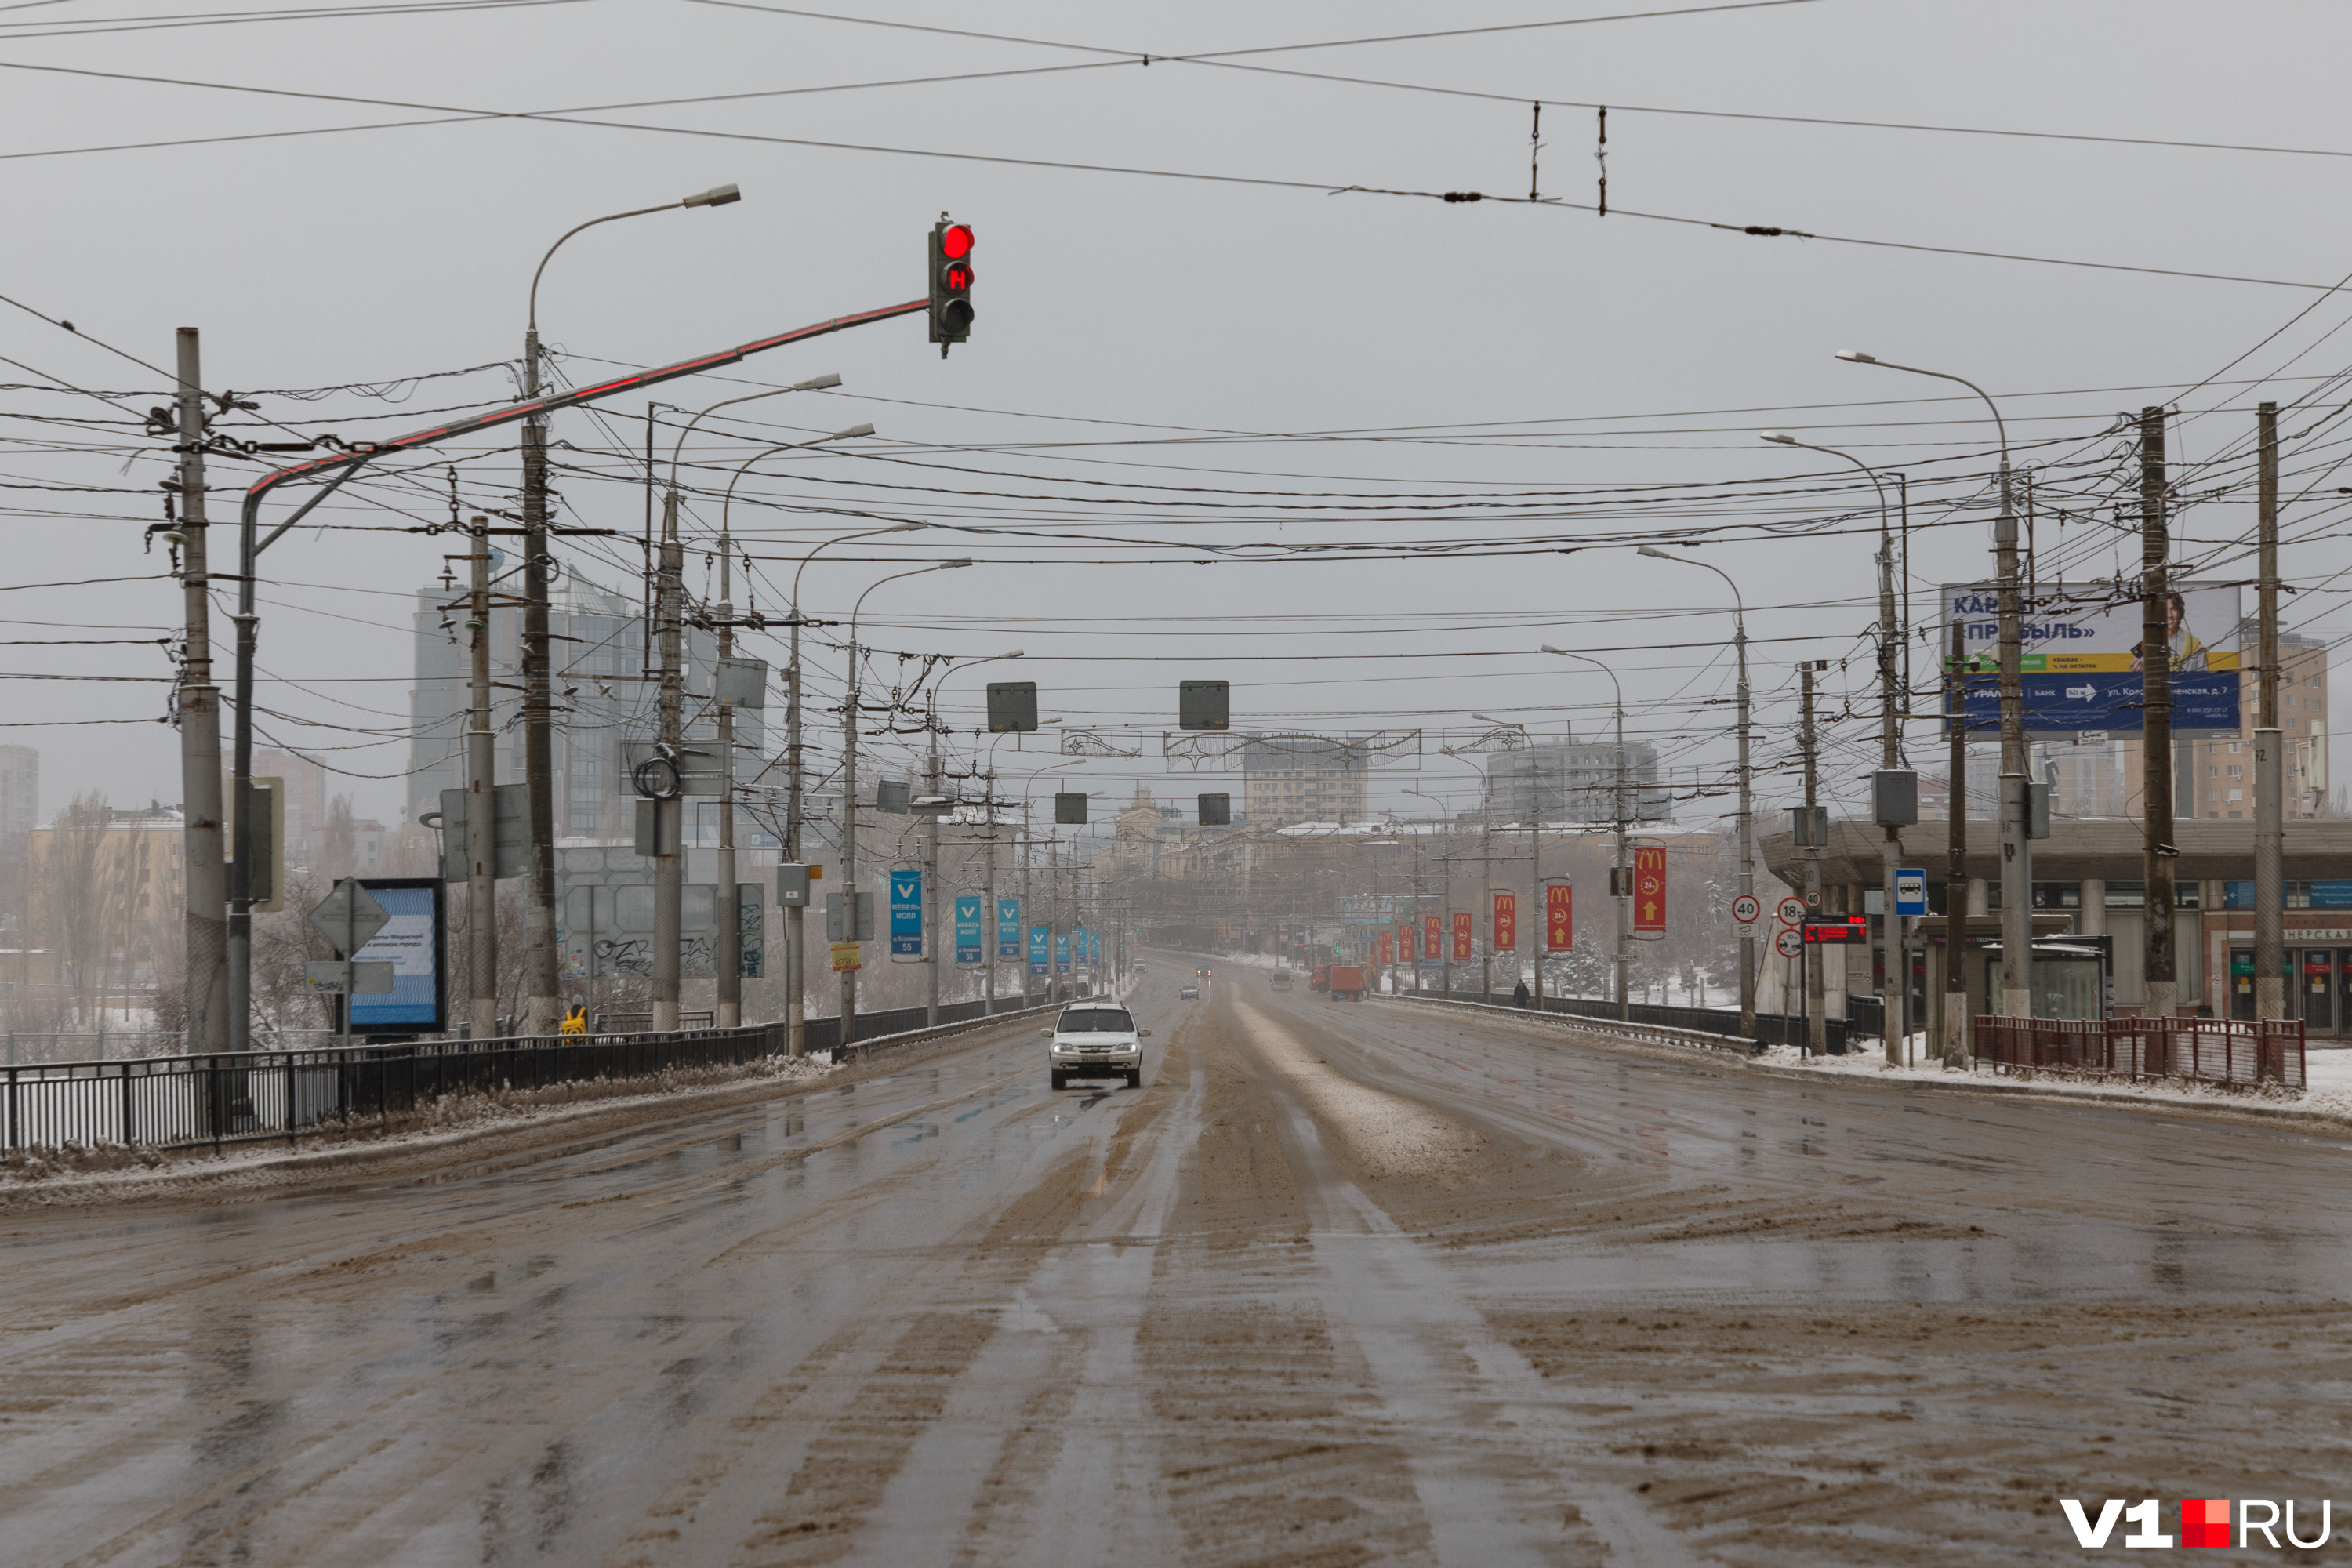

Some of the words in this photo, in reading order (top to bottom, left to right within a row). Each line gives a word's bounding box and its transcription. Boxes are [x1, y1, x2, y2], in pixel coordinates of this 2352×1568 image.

[1955, 598, 2028, 614] КАРА
[2107, 688, 2119, 697] ул.
[1808, 895, 1818, 904] 40
[1737, 903, 1754, 914] 40
